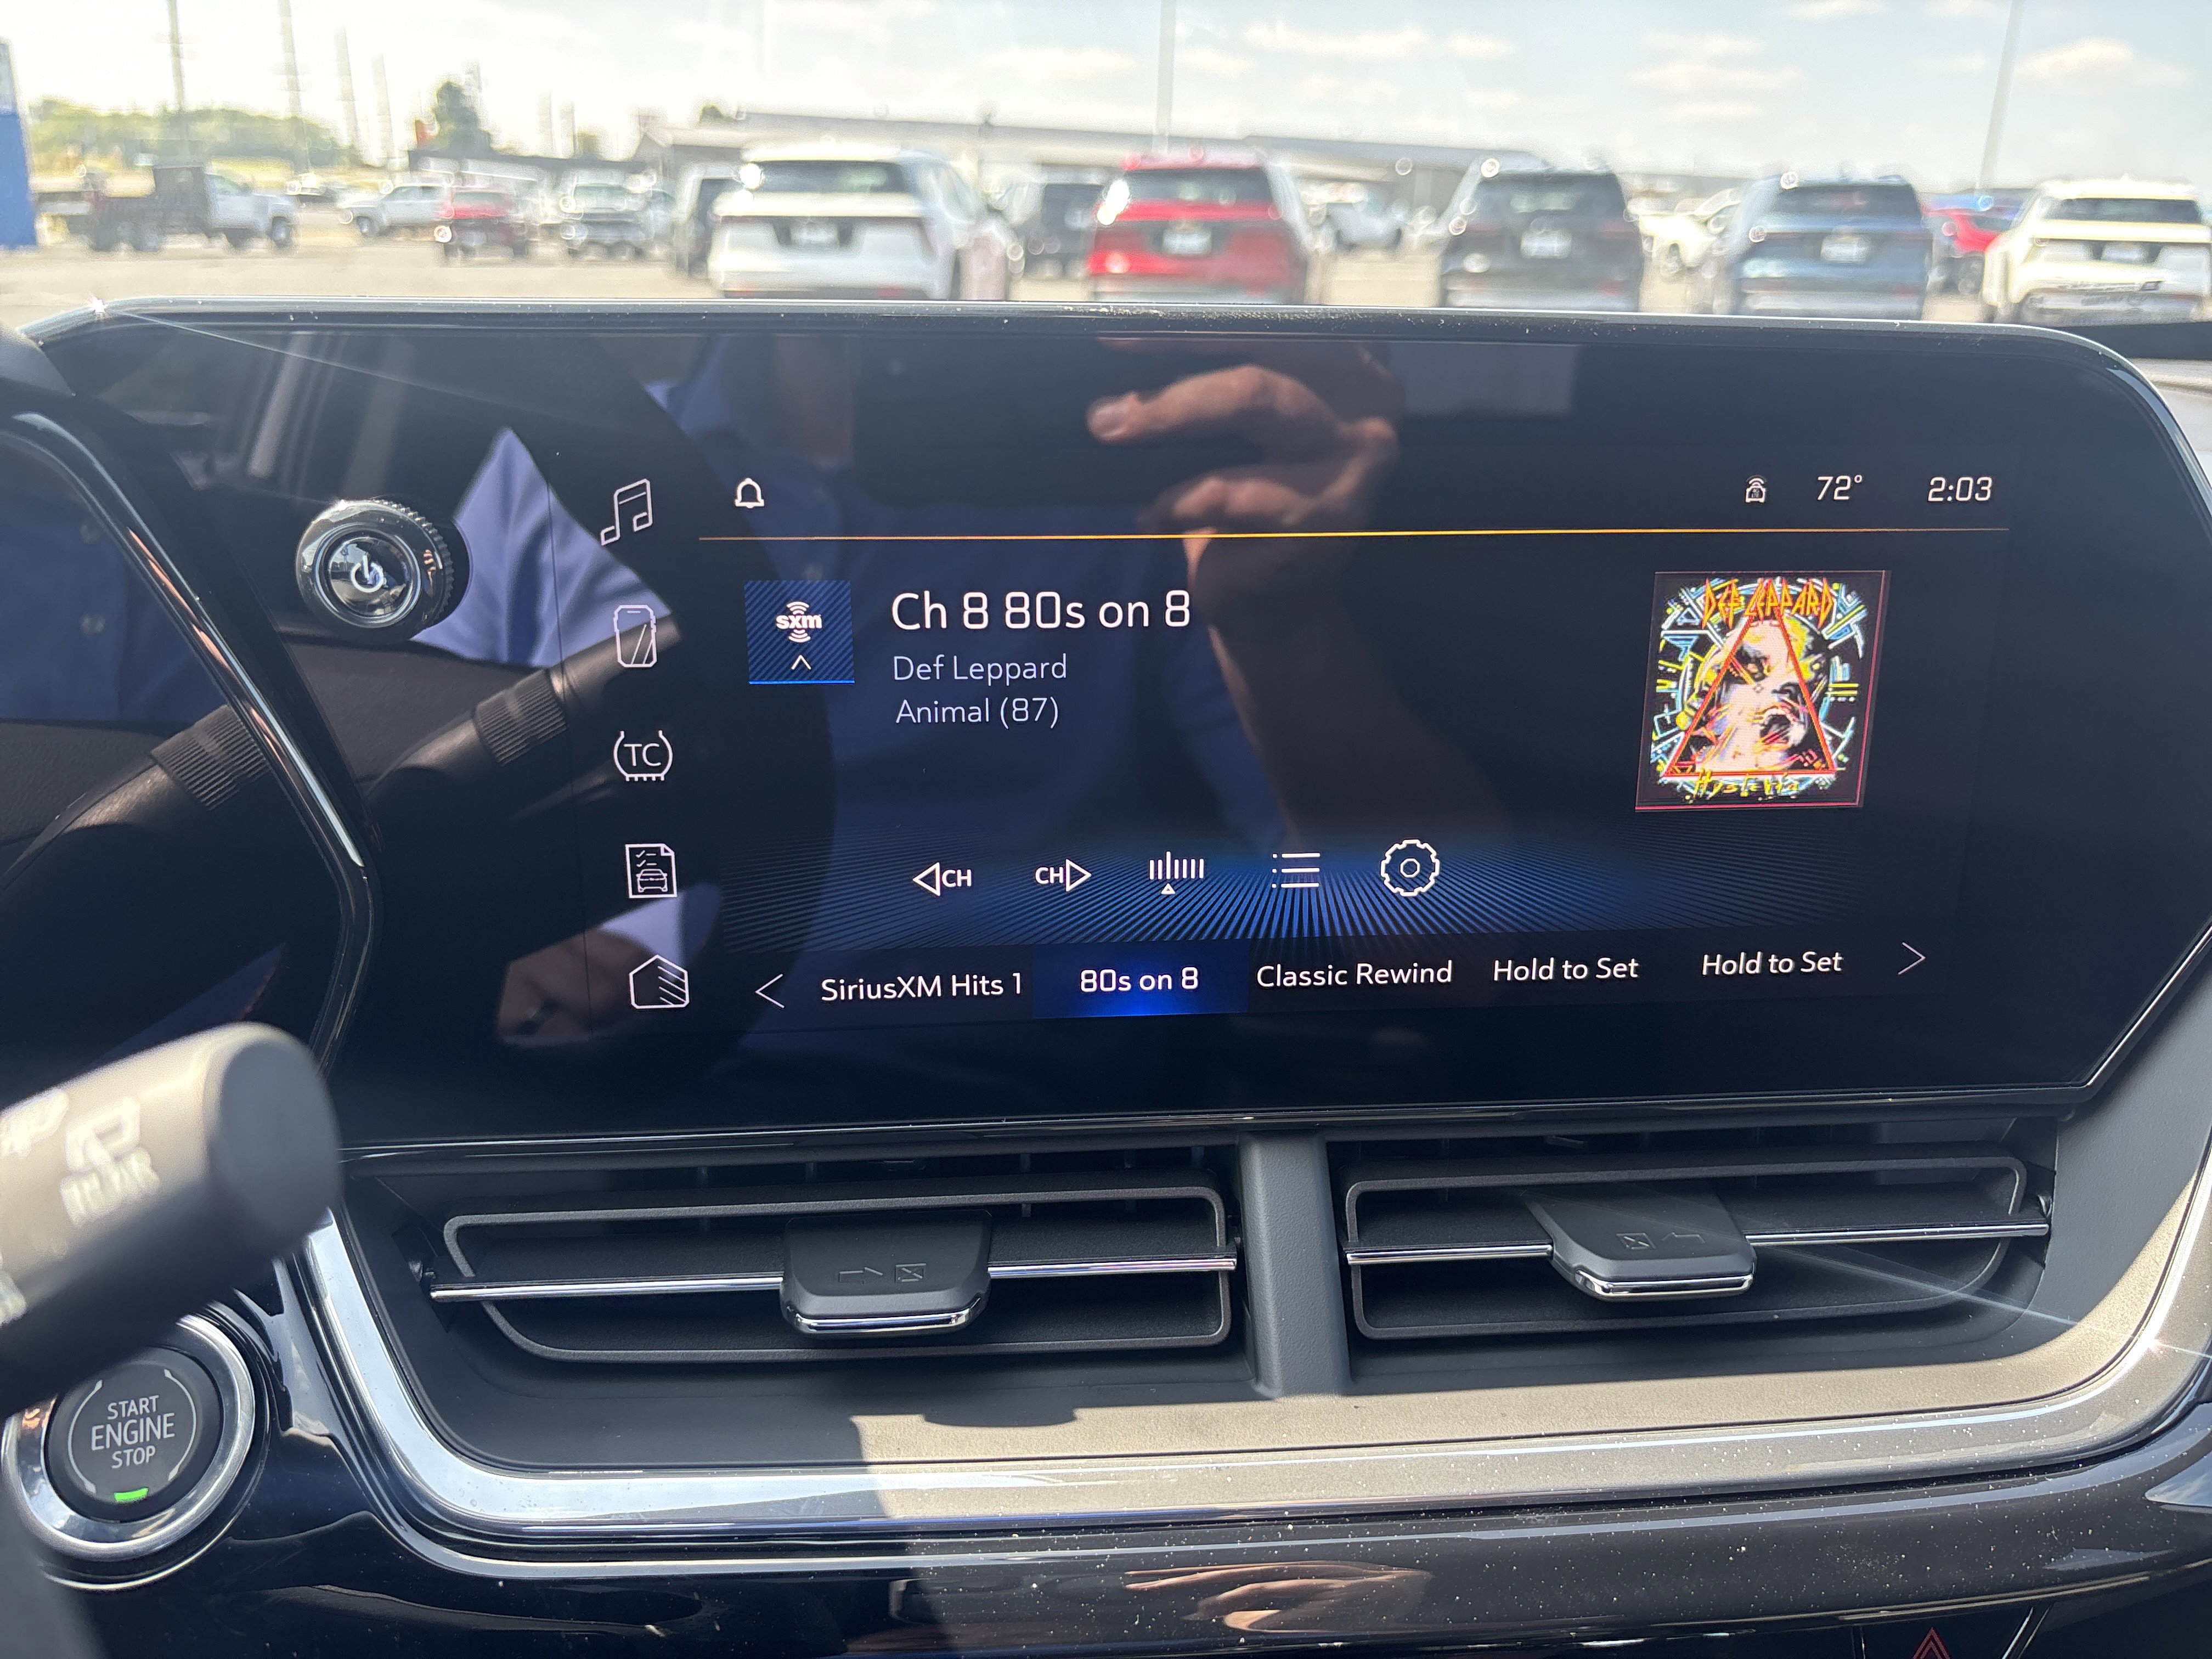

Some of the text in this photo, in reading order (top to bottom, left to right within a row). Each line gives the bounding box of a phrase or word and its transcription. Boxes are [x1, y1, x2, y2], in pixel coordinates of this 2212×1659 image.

[1928, 476, 1993, 501] 2:03
[775, 614, 823, 629] sxm
[892, 590, 1190, 630] Ch 8 80s on 8
[894, 653, 1066, 686] Def Leppard
[895, 696, 1058, 730] Animal (87)
[941, 869, 972, 888] CH
[1035, 866, 1064, 884] CH
[1257, 960, 1452, 987] Classic Rewind
[1494, 957, 1639, 981] Hold to Set
[1702, 951, 1843, 975] Hold to Set
[821, 972, 1020, 1001] SiriusXM Hits 1
[1081, 967, 1198, 992] 80s on 8
[107, 1395, 160, 1420] START
[91, 1412, 176, 1451] ENGINE
[111, 1445, 156, 1469] STOP
